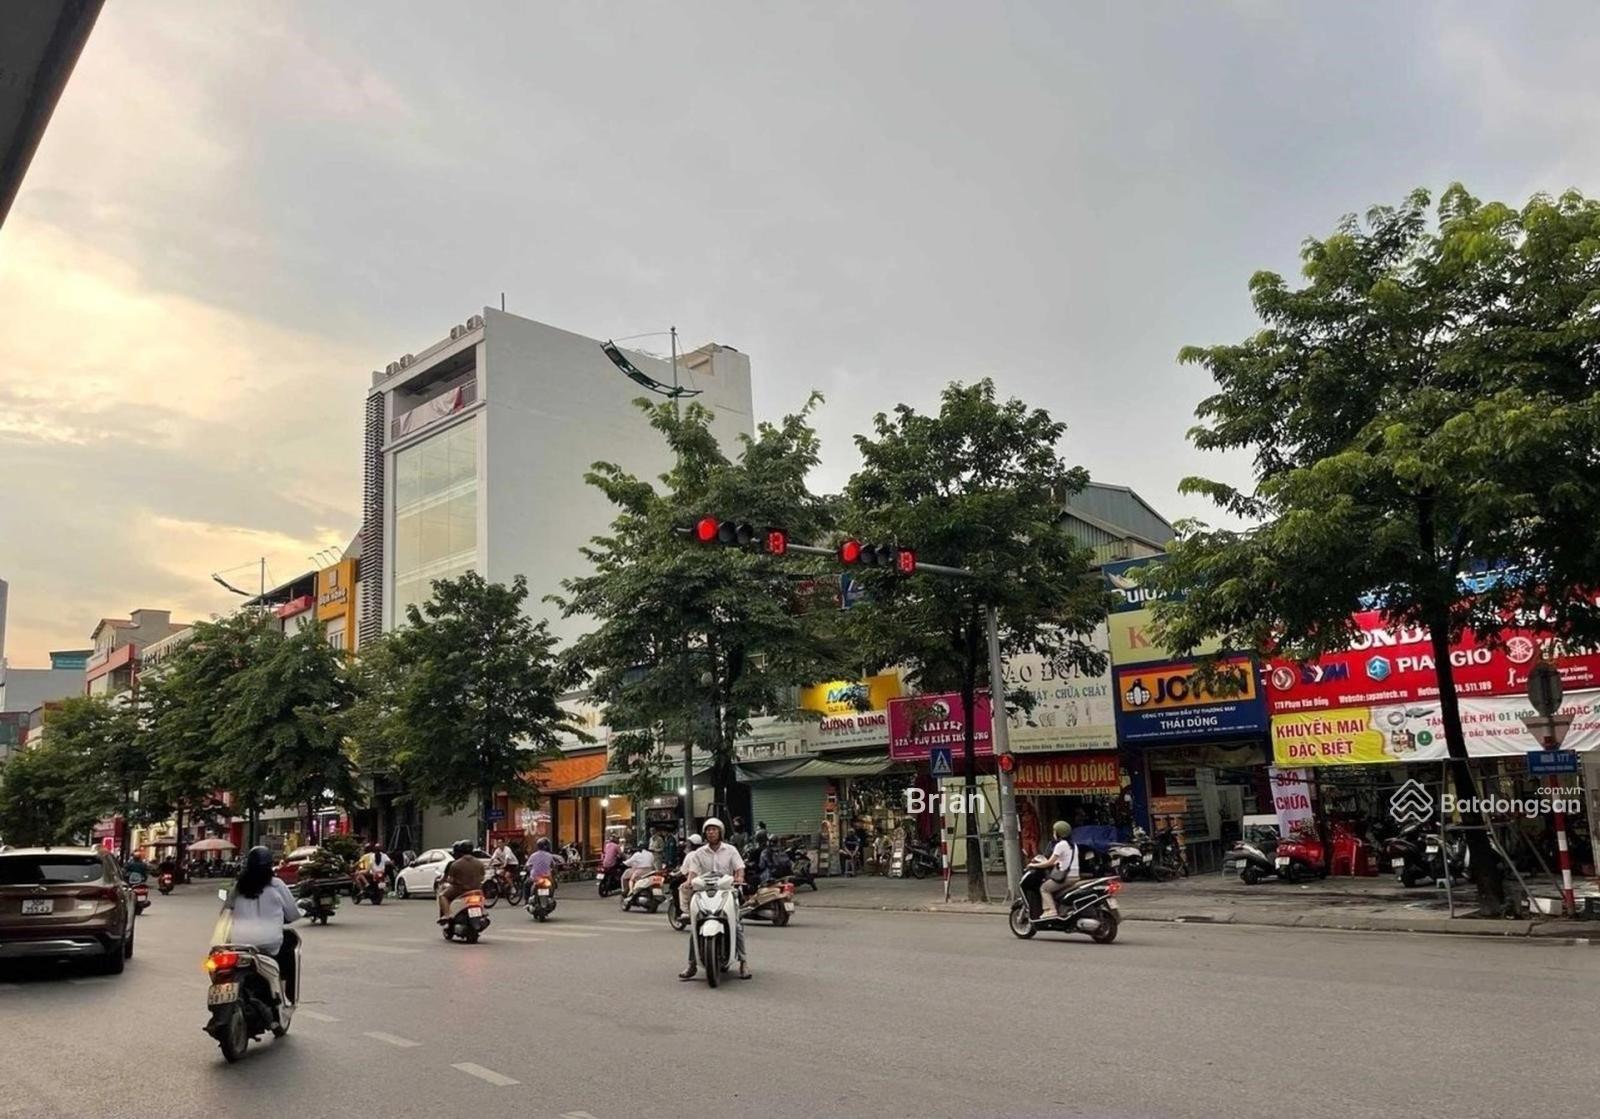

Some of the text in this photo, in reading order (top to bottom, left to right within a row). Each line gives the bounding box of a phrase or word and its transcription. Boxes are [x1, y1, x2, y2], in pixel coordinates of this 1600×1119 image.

[1397, 650, 1492, 673] PIAGIO
[1337, 718, 1365, 736] MẠI
[1322, 738, 1354, 757] BIỆT
[1055, 763, 1078, 783] LAO
